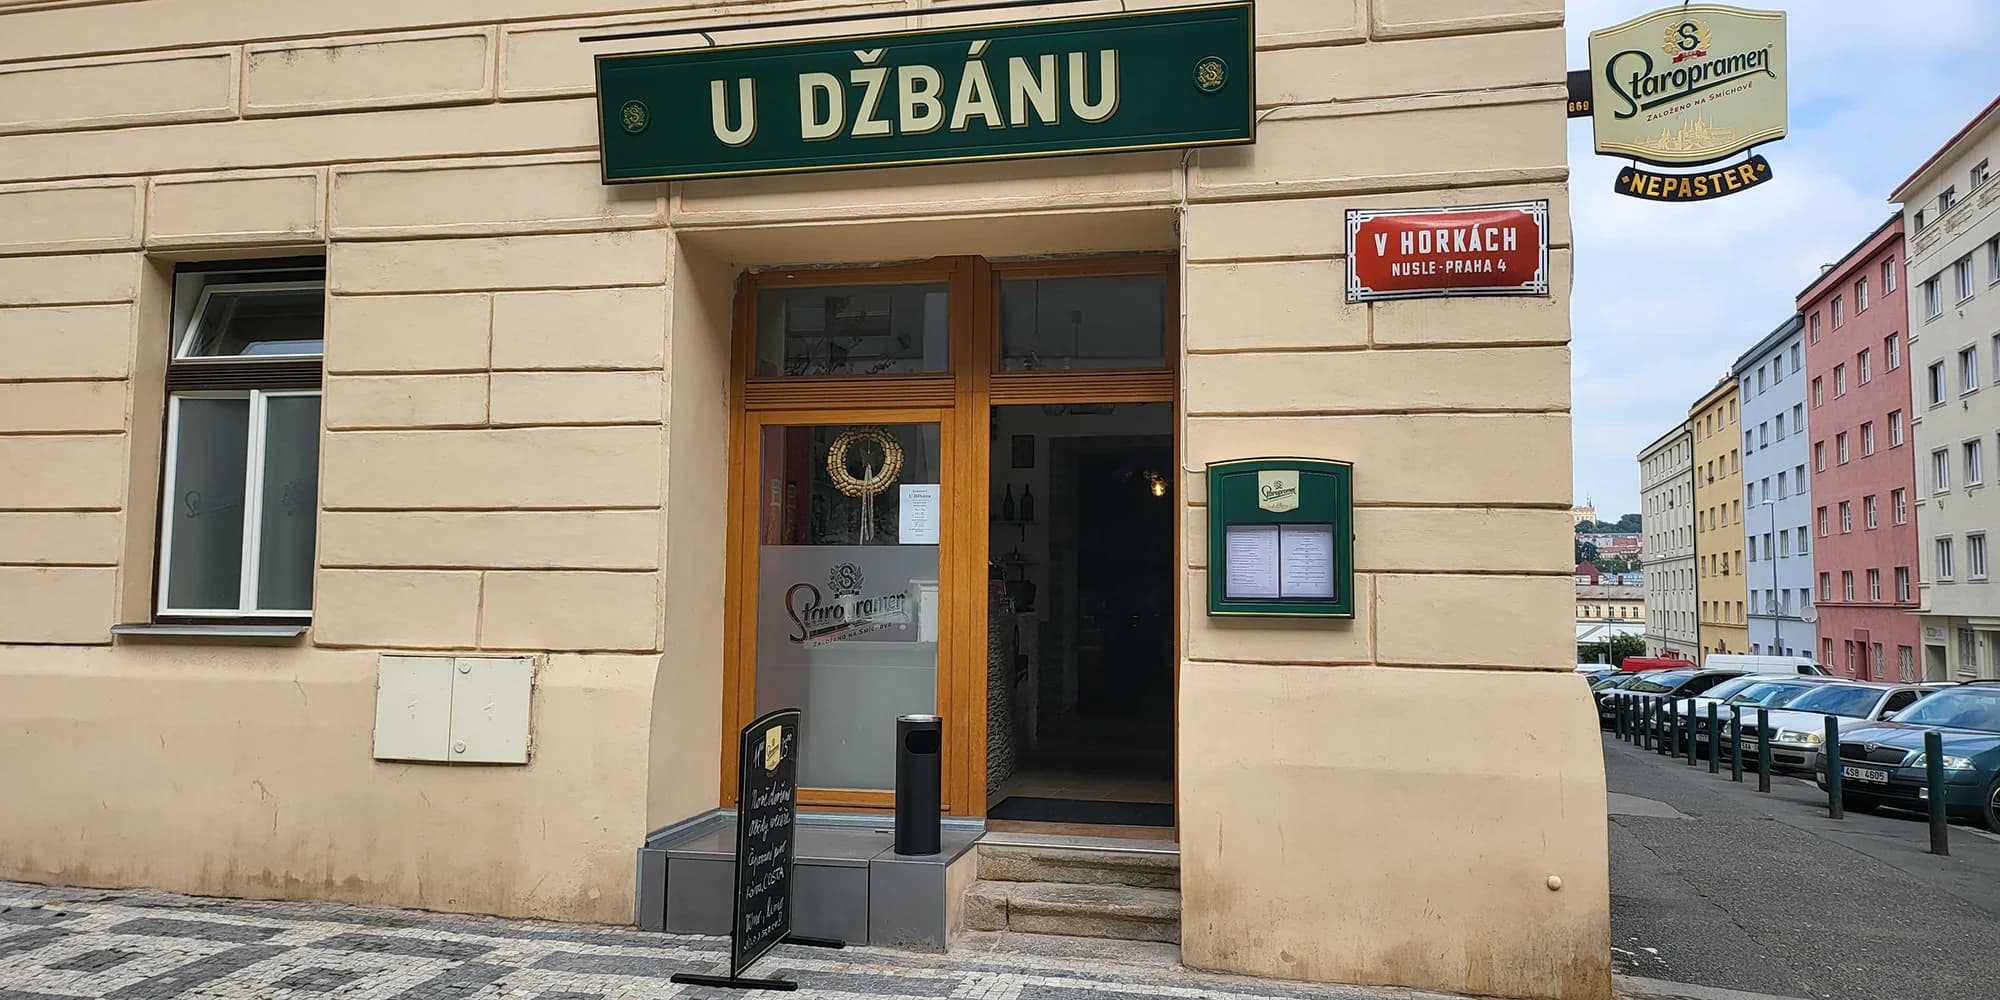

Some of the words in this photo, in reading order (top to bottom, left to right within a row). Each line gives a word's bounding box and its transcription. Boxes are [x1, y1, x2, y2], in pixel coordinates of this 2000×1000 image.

[710, 77, 758, 147] U
[798, 39, 1123, 143] DŽBÁNU
[1605, 46, 1776, 120] Staropramen
[1694, 96, 1707, 107] NA
[1629, 163, 1757, 199] NEPASTER
[1373, 232, 1388, 257] V
[1400, 223, 1517, 255] HORKÁCH
[1497, 258, 1507, 273] 4
